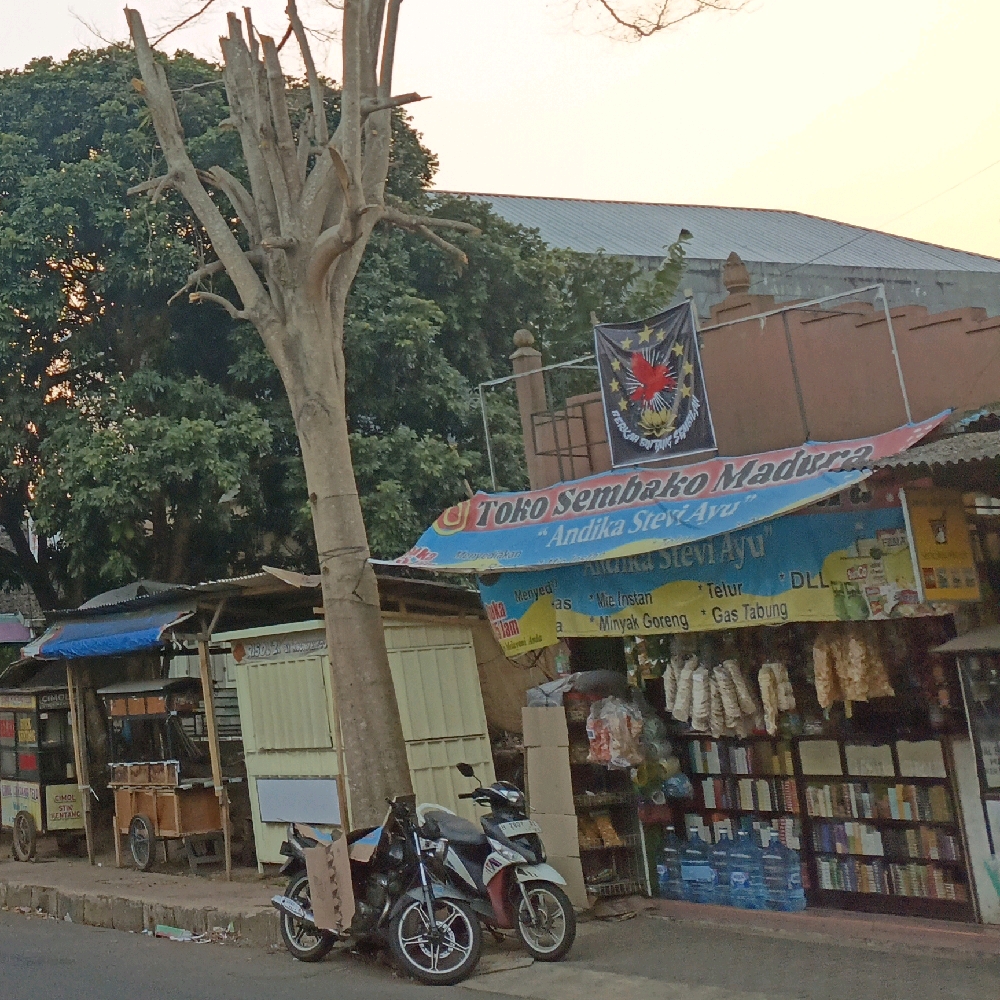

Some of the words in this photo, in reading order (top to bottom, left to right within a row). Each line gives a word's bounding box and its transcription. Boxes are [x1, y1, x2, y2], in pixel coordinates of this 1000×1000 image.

[475, 493, 549, 527] Toko
[552, 472, 709, 517] Sembako
[711, 446, 872, 494] Madura
[627, 507, 688, 539] Stevi
[658, 543, 716, 571] Stevi
[706, 582, 743, 600] Telur
[790, 571, 830, 590] DLL
[617, 591, 653, 608] Instan
[599, 616, 639, 633] Minyak
[642, 612, 690, 631] Goreng
[711, 606, 738, 624] Gas
[743, 601, 789, 620] Tabung
